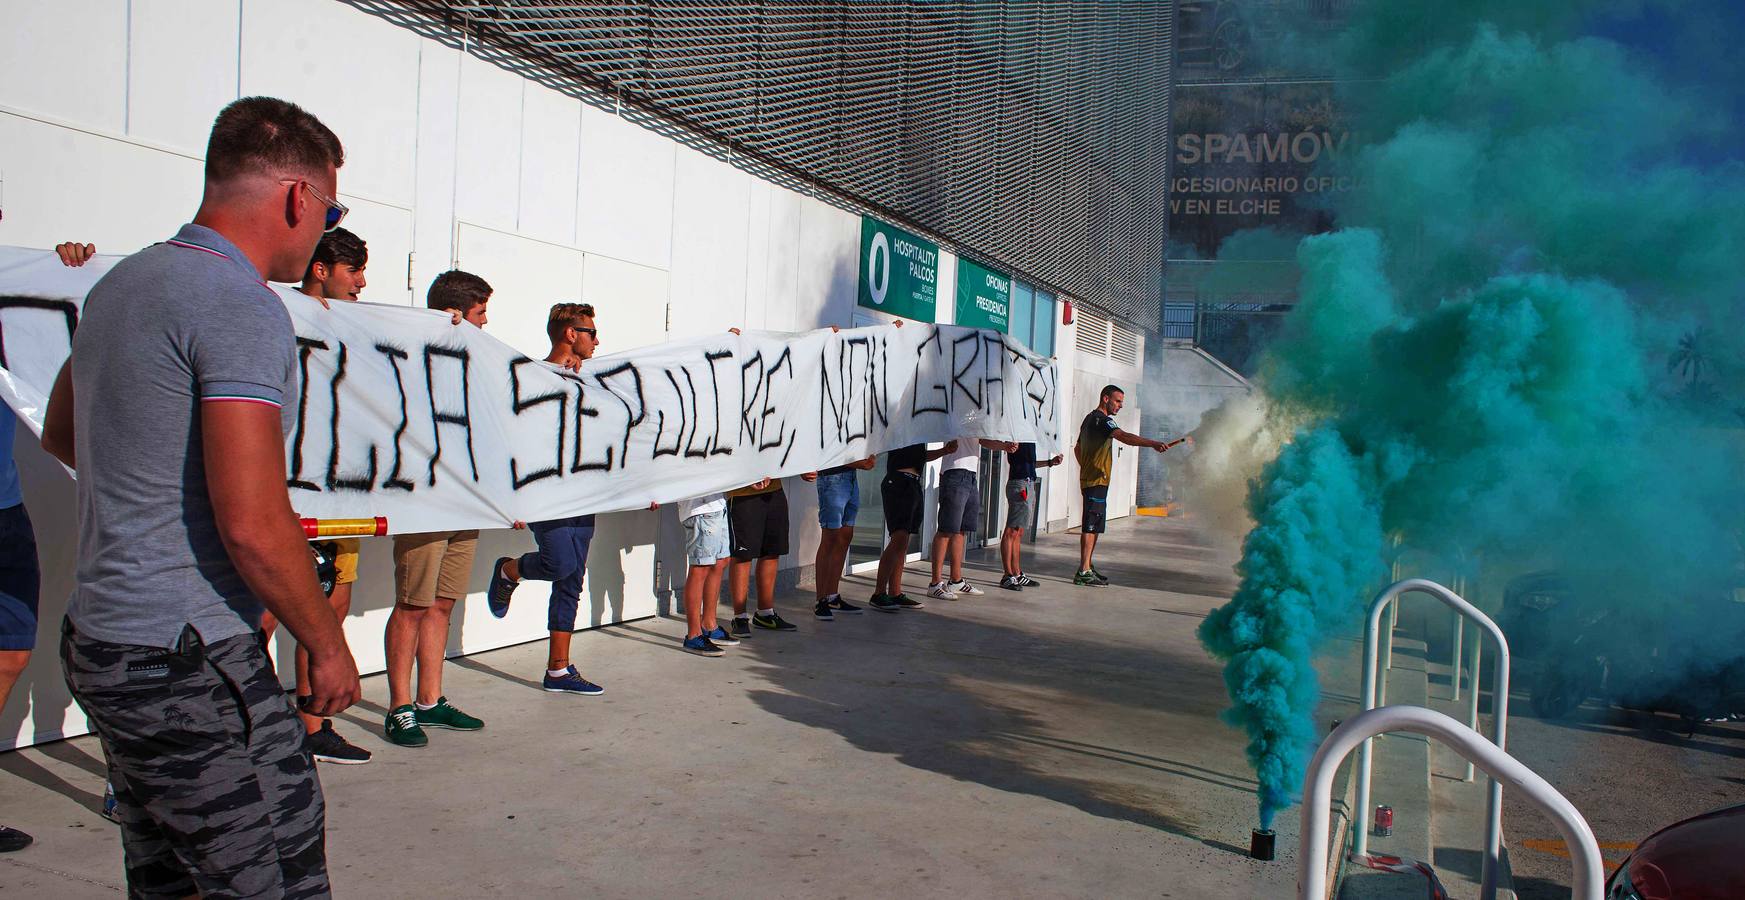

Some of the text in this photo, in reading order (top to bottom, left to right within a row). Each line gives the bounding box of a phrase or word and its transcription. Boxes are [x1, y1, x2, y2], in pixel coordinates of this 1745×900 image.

[1185, 199, 1211, 214] EN
[1216, 199, 1280, 214] ELCHE
[894, 238, 936, 267] HOSPITALITY
[909, 262, 935, 283] PALCOS
[985, 274, 1008, 294] OFICINAS
[975, 295, 1007, 317] PRESIDENCIA
[286, 334, 479, 492] ILIA
[820, 335, 888, 450] NON
